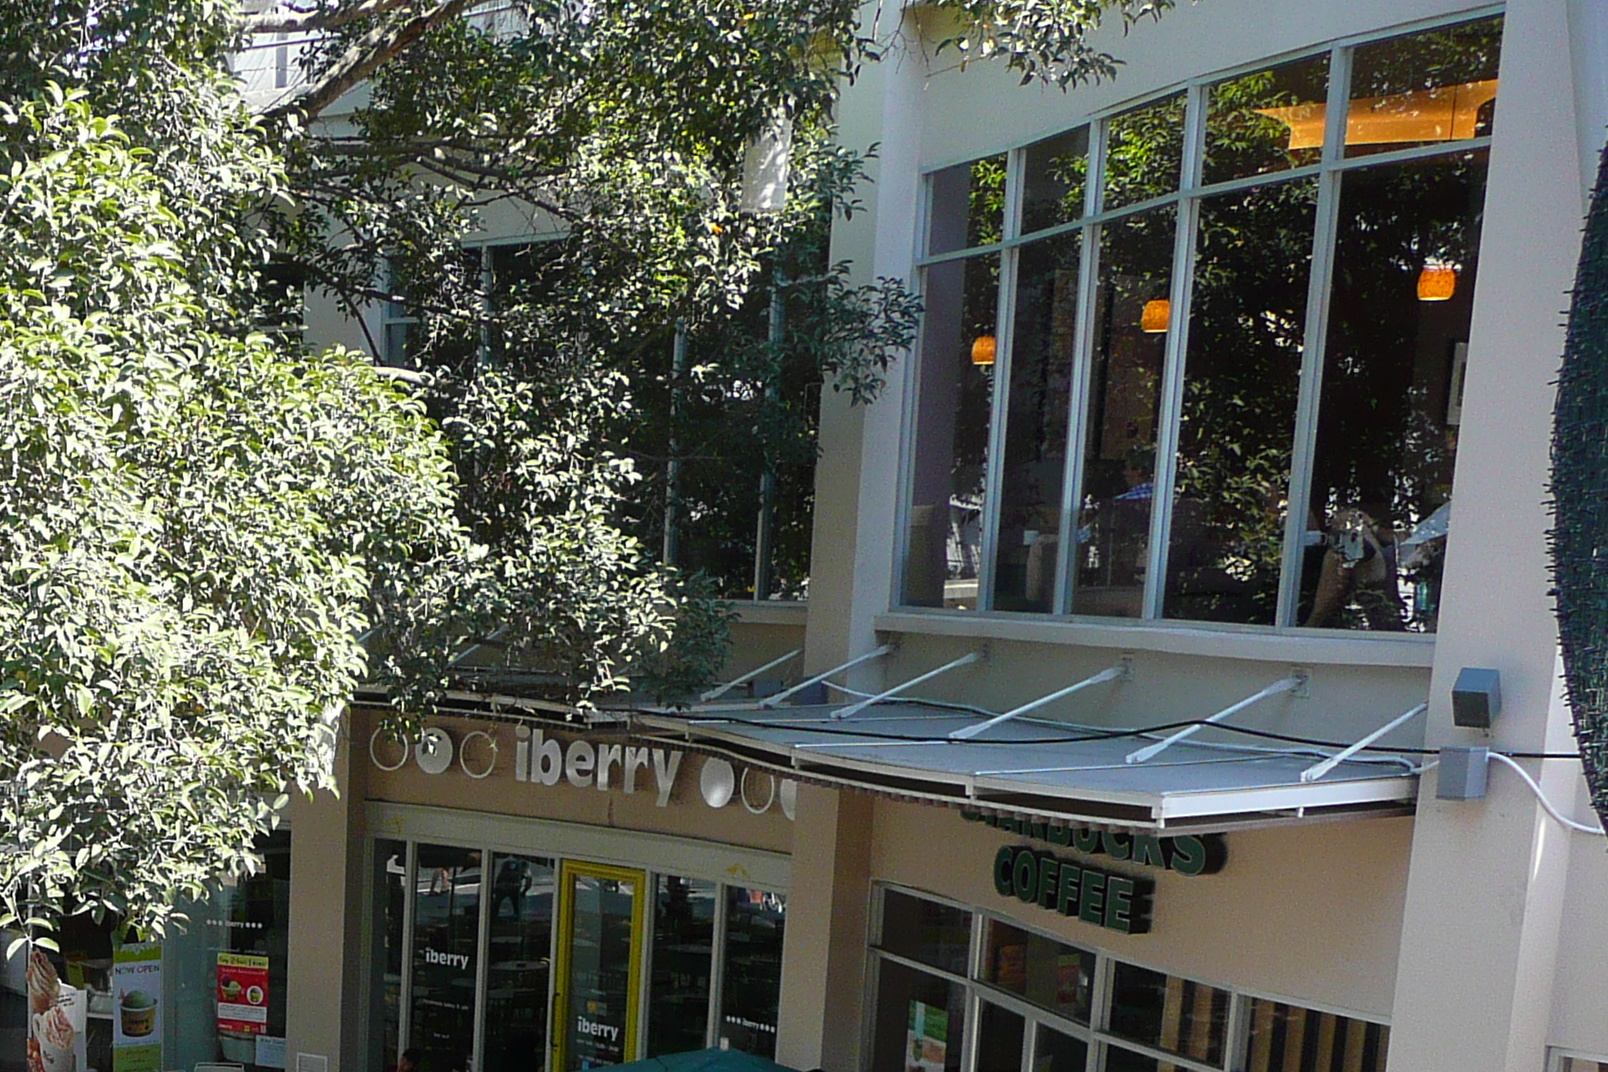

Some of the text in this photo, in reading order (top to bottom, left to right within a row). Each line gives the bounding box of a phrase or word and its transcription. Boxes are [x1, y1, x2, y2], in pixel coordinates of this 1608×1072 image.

[515, 724, 683, 808] iberry
[994, 845, 1135, 934] COFFEE
[136, 964, 160, 974] OPEN
[425, 947, 469, 970] iberry
[577, 1016, 619, 1042] iberry
